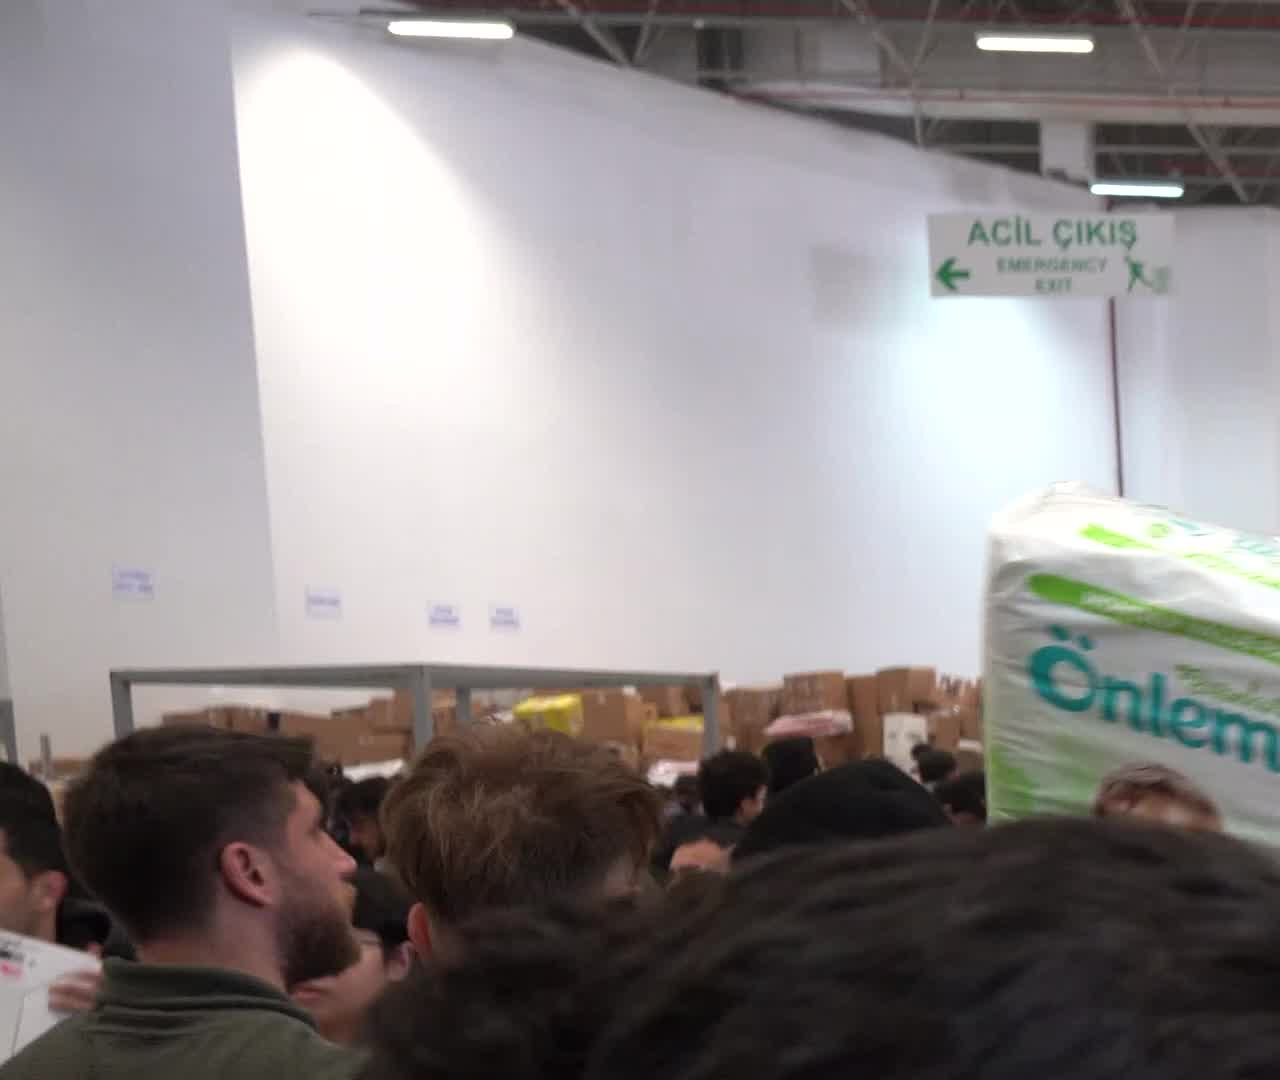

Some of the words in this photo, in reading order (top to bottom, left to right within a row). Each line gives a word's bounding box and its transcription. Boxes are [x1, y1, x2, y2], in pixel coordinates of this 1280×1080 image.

[967, 216, 1042, 246] ACİL
[1052, 219, 1137, 250] ÇIKIŞ
[996, 256, 1107, 273] EMERGENCY
[1035, 279, 1073, 293] EXIT
